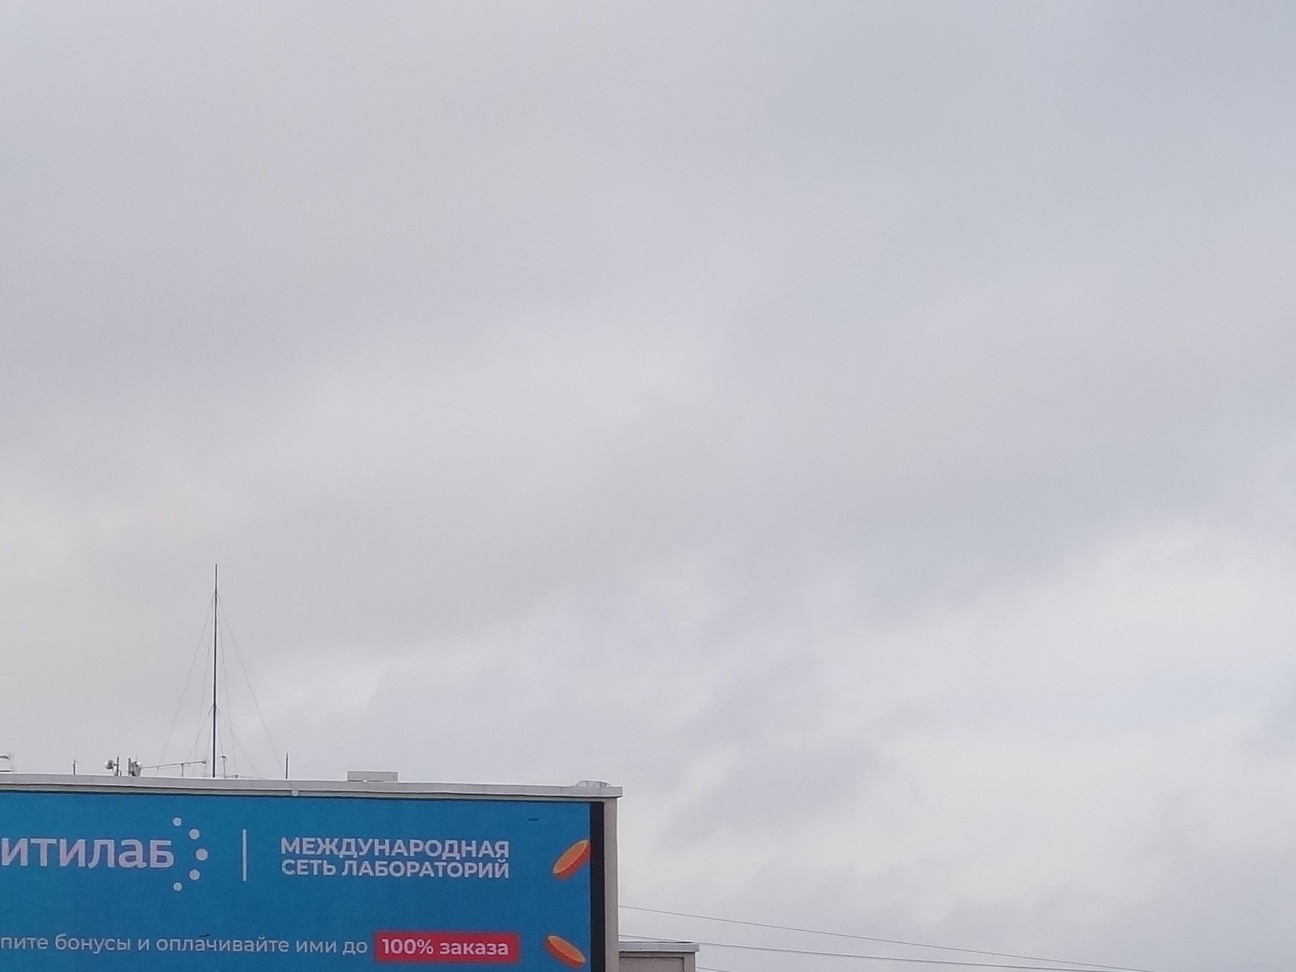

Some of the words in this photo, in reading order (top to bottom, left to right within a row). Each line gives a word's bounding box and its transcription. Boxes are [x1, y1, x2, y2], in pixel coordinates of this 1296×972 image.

[281, 837, 510, 860] МЕЖДУНАРОДНАЯ
[281, 859, 337, 876] СЕТЬ
[341, 858, 510, 879] ЛАБОРАТОРИЙ
[54, 933, 131, 954] бонусы
[138, 938, 150, 951] и
[156, 936, 290, 954] оплачивайте
[295, 940, 337, 953] ими
[342, 941, 368, 956] до
[381, 938, 435, 955] 100%
[439, 941, 510, 956] заказа
